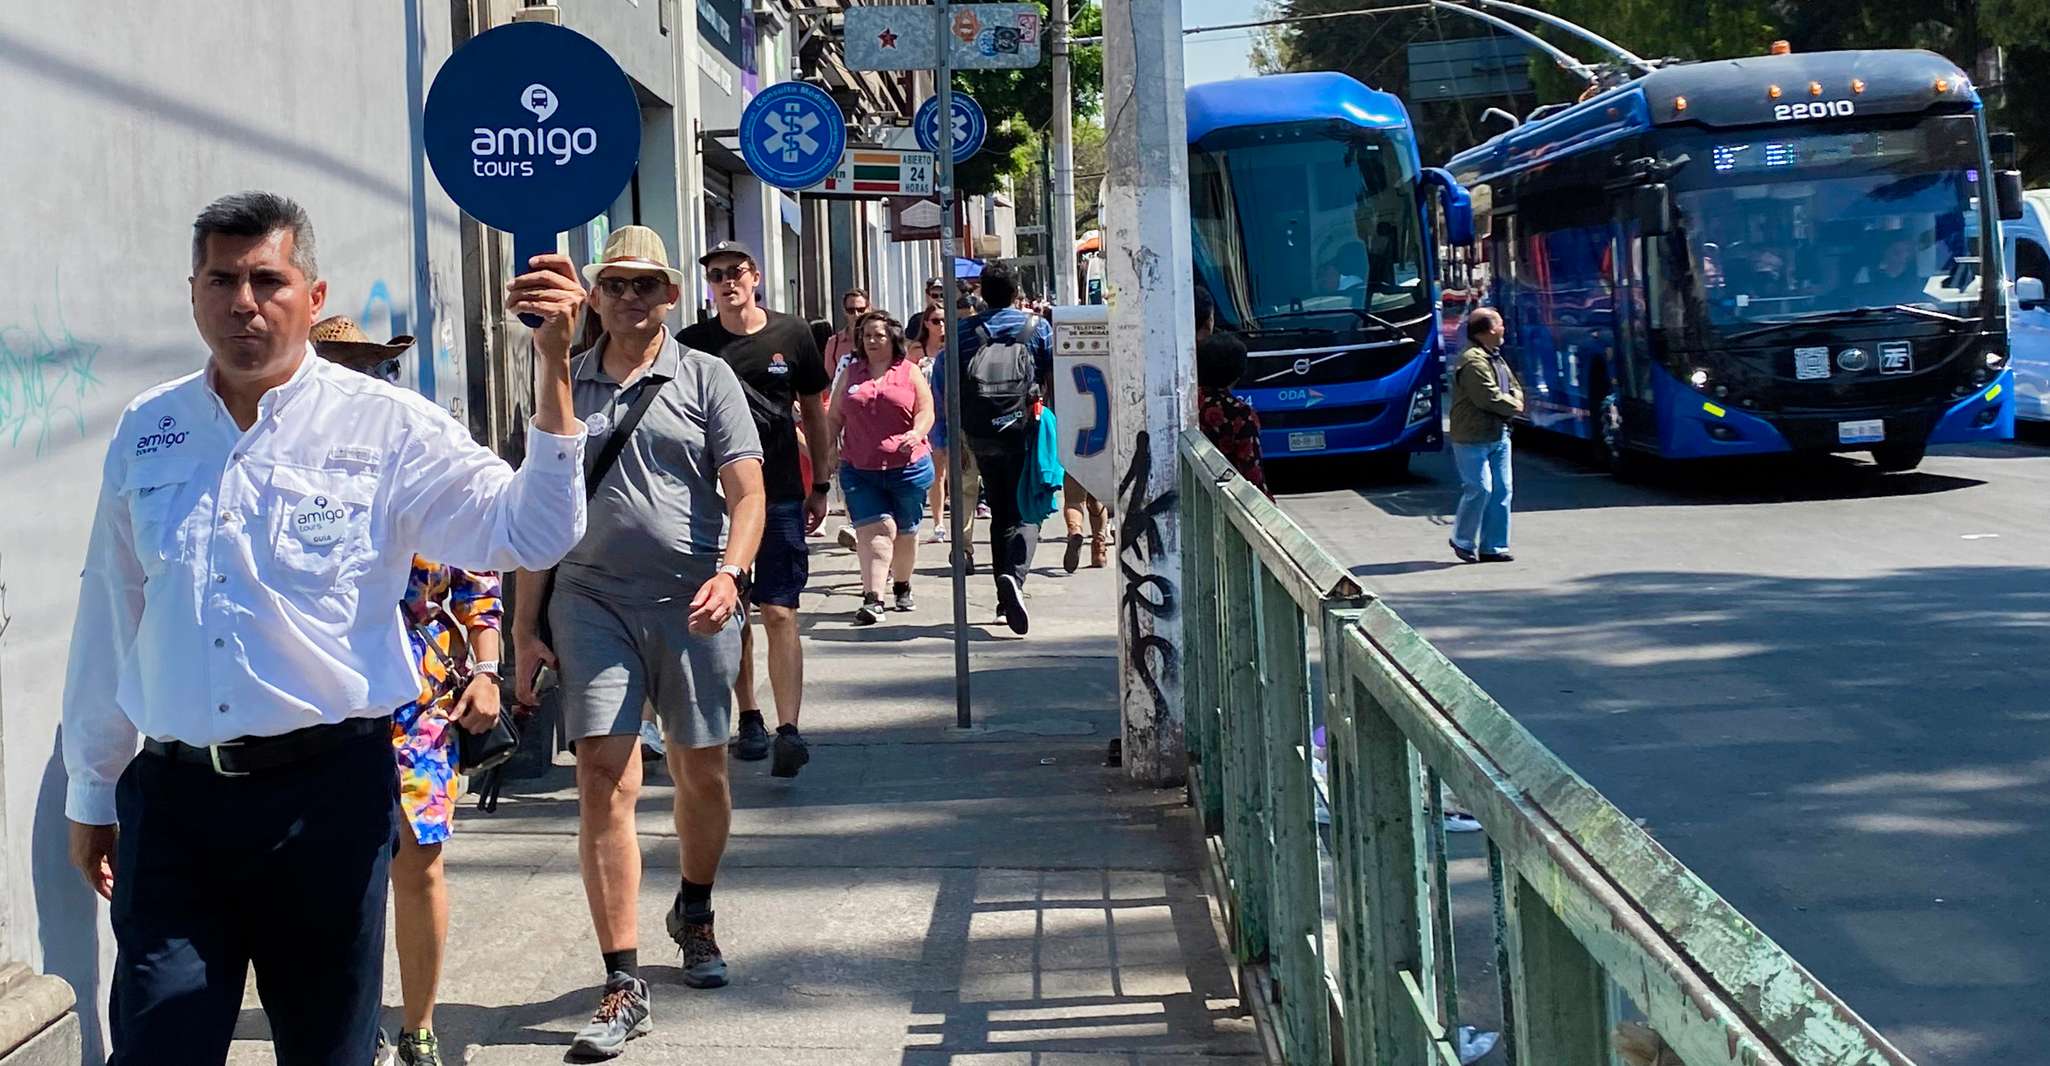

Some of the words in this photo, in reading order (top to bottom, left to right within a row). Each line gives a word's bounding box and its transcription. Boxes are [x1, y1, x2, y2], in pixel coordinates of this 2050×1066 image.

[1774, 99, 1855, 121] 22010
[471, 127, 597, 166] amigo
[473, 158, 534, 177] tours
[903, 155, 931, 165] ABIERTO
[910, 167, 925, 182] 24
[905, 183, 929, 193] HORAS
[1278, 389, 1306, 401] ODA
[136, 431, 186, 449] amigo
[297, 508, 345, 525] amigo
[299, 522, 323, 533] tours
